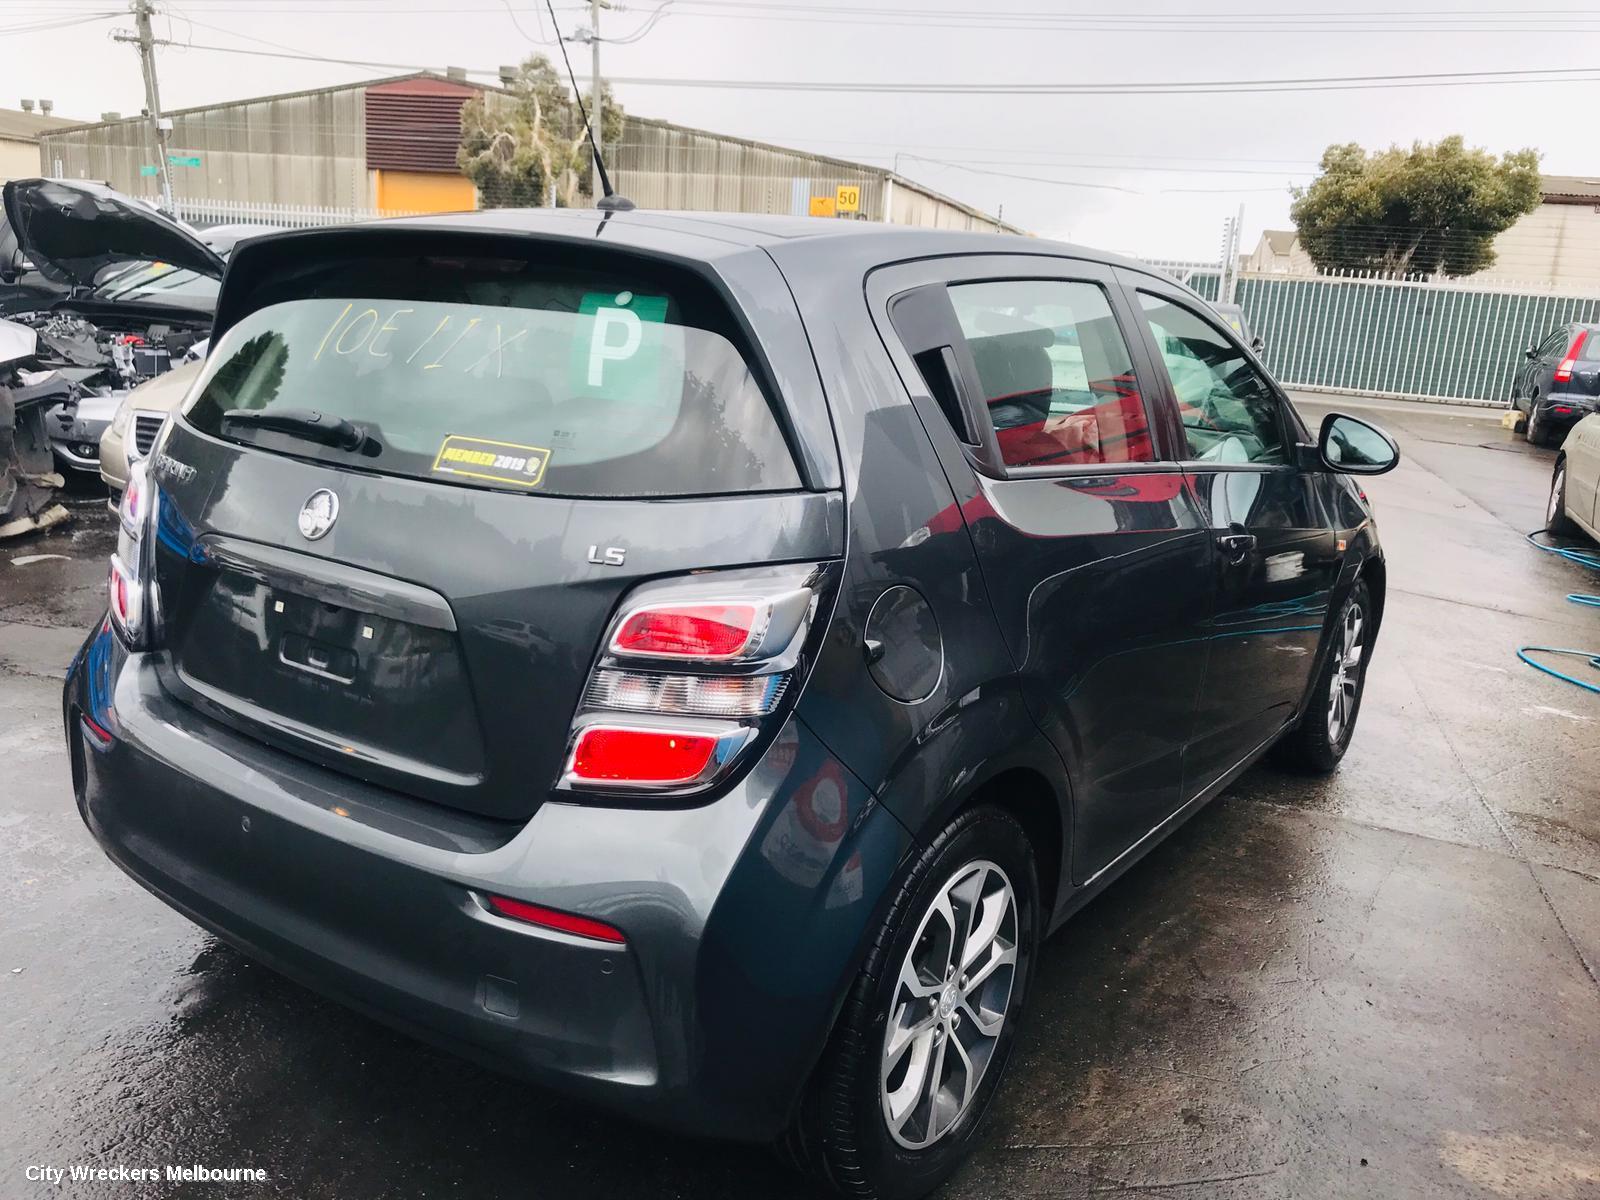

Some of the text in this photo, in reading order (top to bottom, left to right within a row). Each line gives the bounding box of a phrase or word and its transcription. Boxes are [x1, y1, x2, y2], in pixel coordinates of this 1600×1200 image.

[839, 191, 857, 205] 50
[587, 307, 643, 387] P
[588, 545, 626, 567] LS
